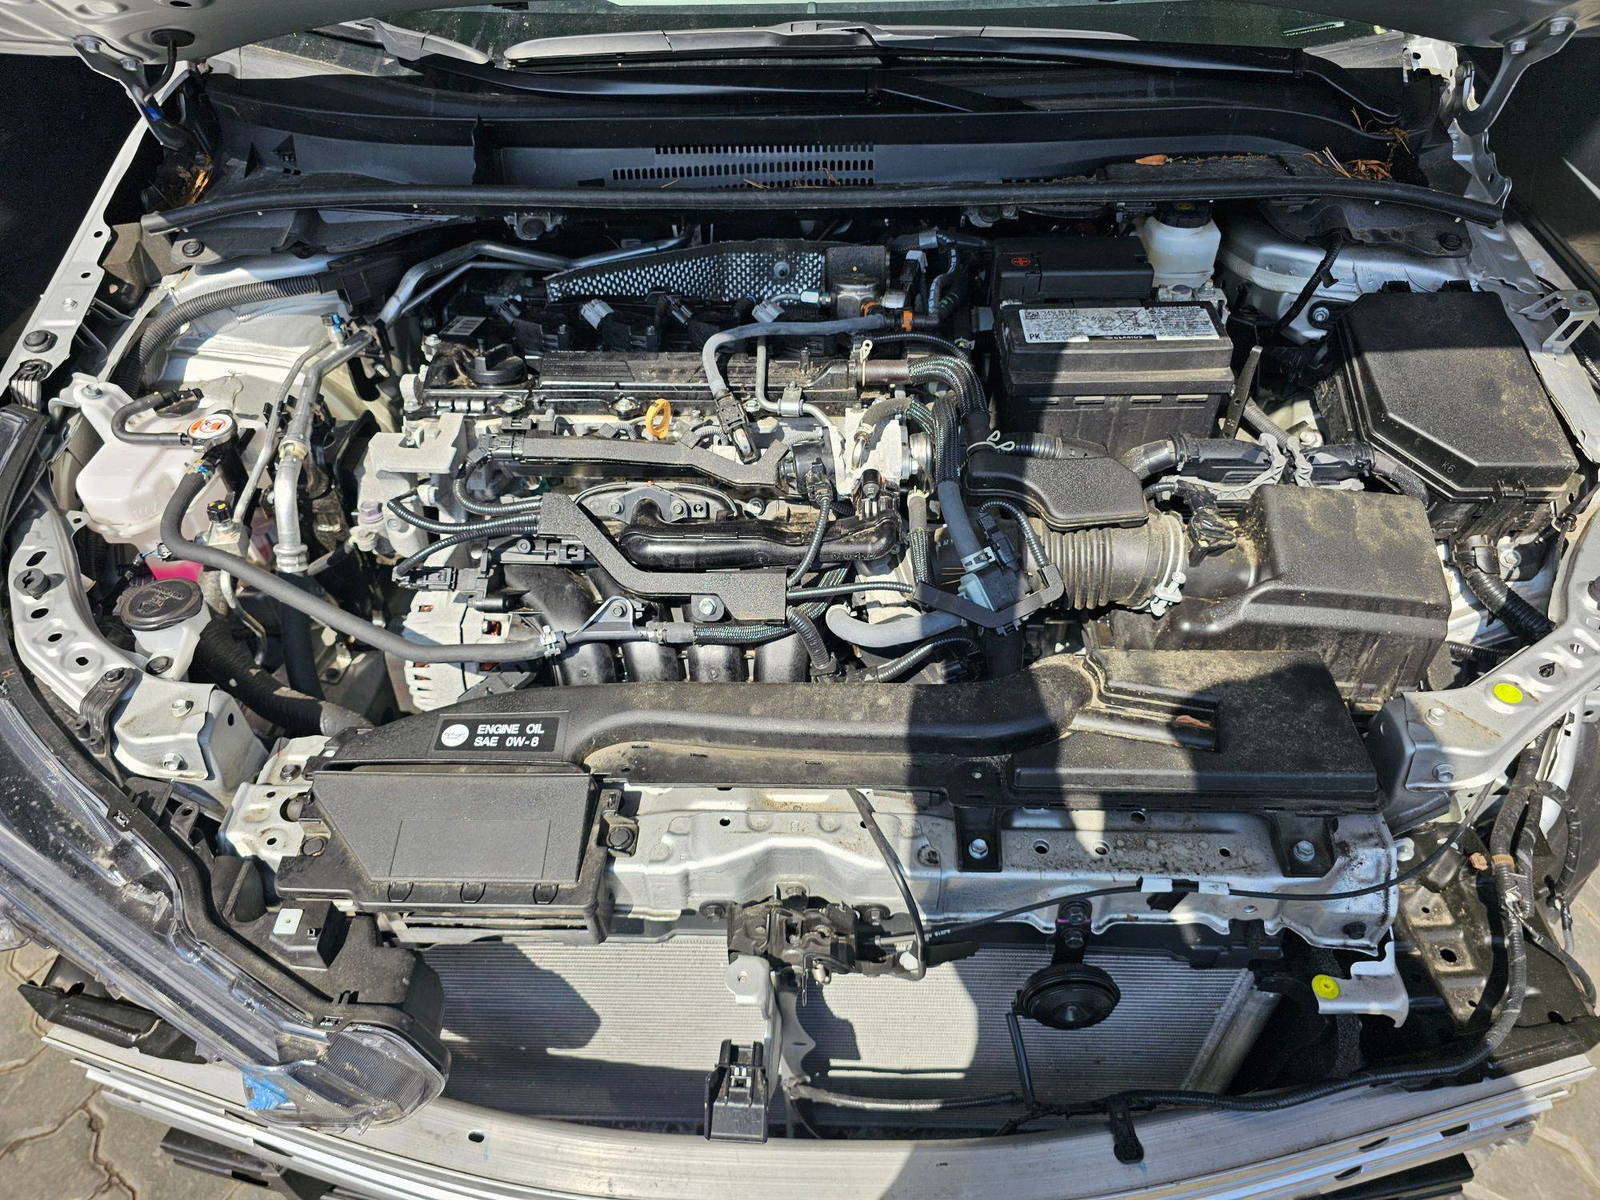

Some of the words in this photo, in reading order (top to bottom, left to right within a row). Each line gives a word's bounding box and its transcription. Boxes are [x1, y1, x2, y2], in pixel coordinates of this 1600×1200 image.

[1029, 333, 1041, 341] PK
[476, 723, 519, 735] ENGINE
[525, 723, 545, 735] OIL
[473, 736, 498, 747] SAE
[505, 736, 539, 747] 0W-8
